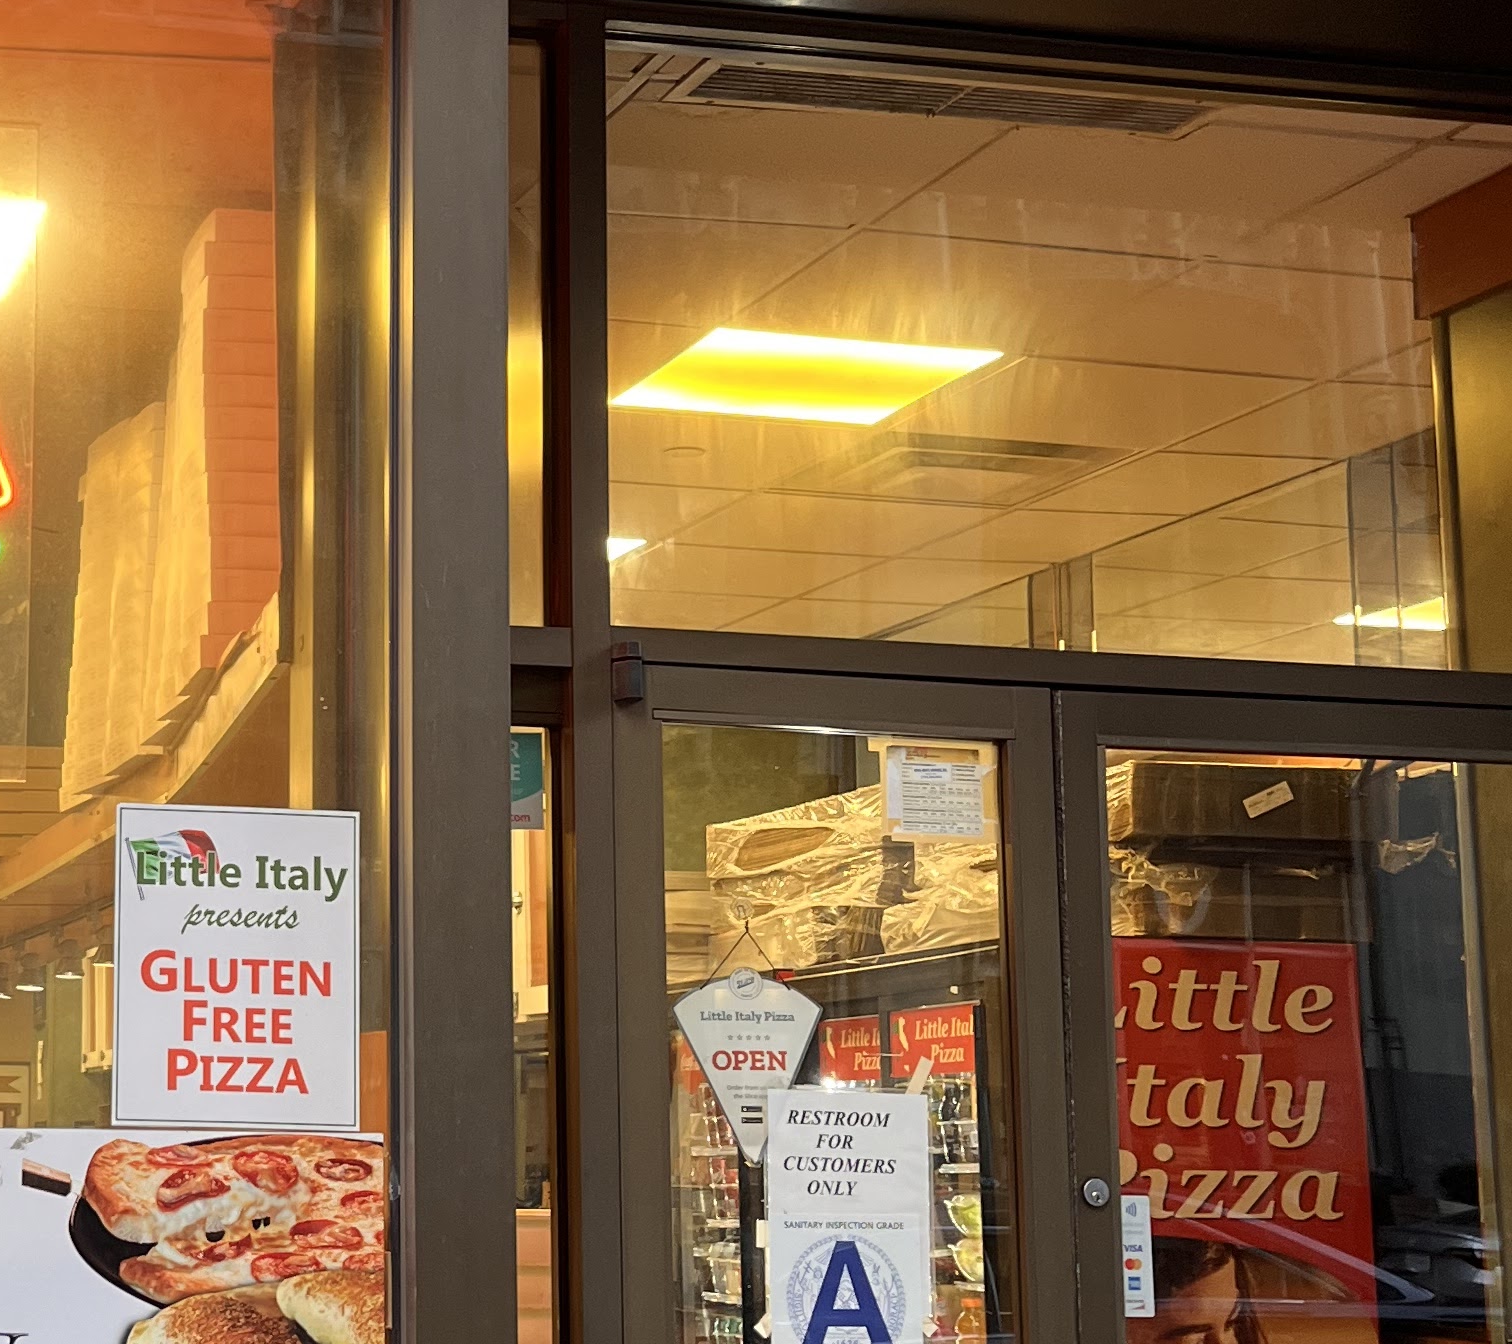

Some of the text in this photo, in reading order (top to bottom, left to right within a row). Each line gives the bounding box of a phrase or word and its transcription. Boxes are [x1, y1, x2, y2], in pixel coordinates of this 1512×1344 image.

[137, 850, 348, 902] Little Italy
[181, 904, 299, 934] presents
[140, 949, 332, 997] GLUTEN
[183, 999, 293, 1044] FREE
[700, 1011, 795, 1024] Little Italy Pizza
[915, 1014, 975, 1041] Little Ital
[840, 1027, 870, 1048] Little
[711, 1050, 788, 1071] OPEN
[930, 1042, 965, 1063] Pizza
[167, 1048, 309, 1094] PIZZA
[1115, 1054, 1326, 1149] taly
[787, 1109, 891, 1128] RESTROOM
[816, 1133, 854, 1150] FOR
[783, 1156, 897, 1175] CUSTOMERS
[807, 1179, 857, 1197] ONLY
[784, 1221, 904, 1230] SANITARY INSPECTION GRADE
[1124, 1244, 1143, 1253] VISA
